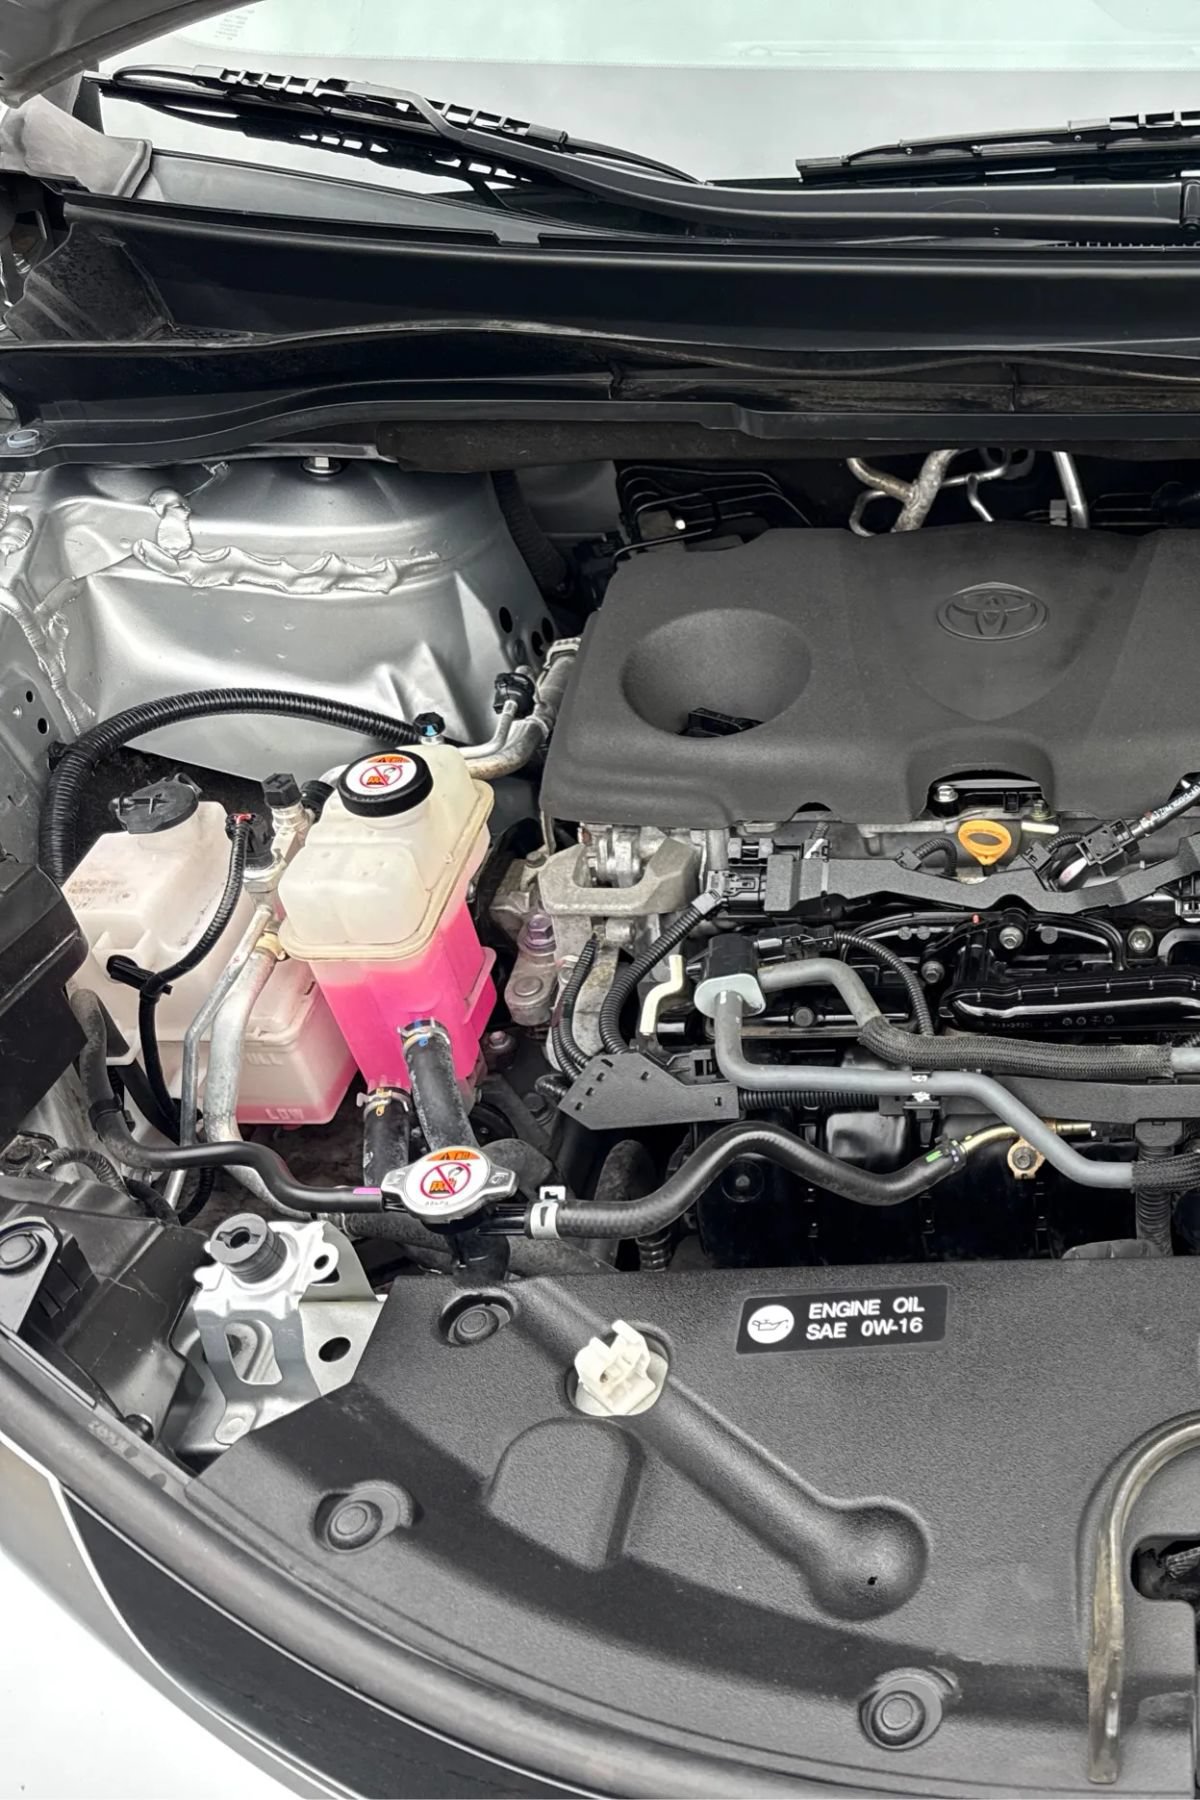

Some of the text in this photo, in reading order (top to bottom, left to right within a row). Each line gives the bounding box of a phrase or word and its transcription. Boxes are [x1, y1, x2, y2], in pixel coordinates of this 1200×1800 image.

[264, 1107, 305, 1120] LOW
[808, 1296, 925, 1320] ENGINE OIL
[805, 1316, 924, 1341] SAE 0W-16
